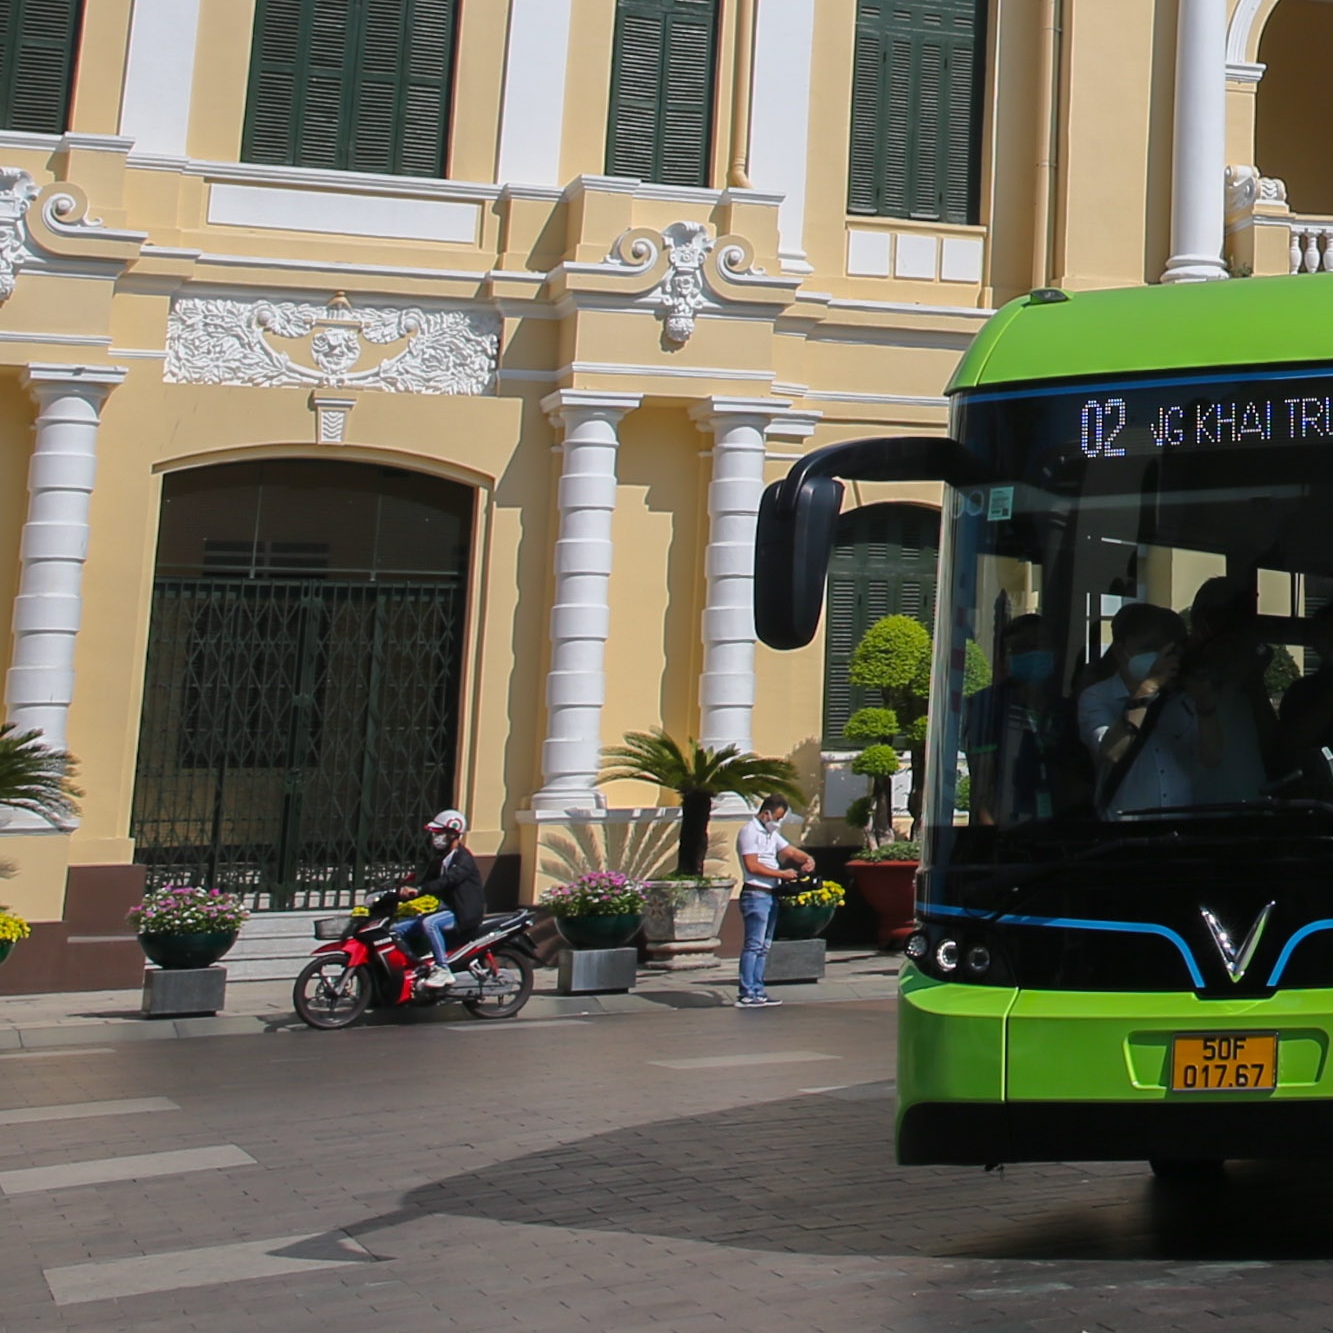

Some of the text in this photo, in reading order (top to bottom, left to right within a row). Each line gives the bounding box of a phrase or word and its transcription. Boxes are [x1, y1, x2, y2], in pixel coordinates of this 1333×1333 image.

[1081, 398, 1126, 458] 02
[1196, 400, 1271, 444] KHAI
[1202, 1036, 1247, 1061] 50F
[1183, 1063, 1265, 1089] 017.67
